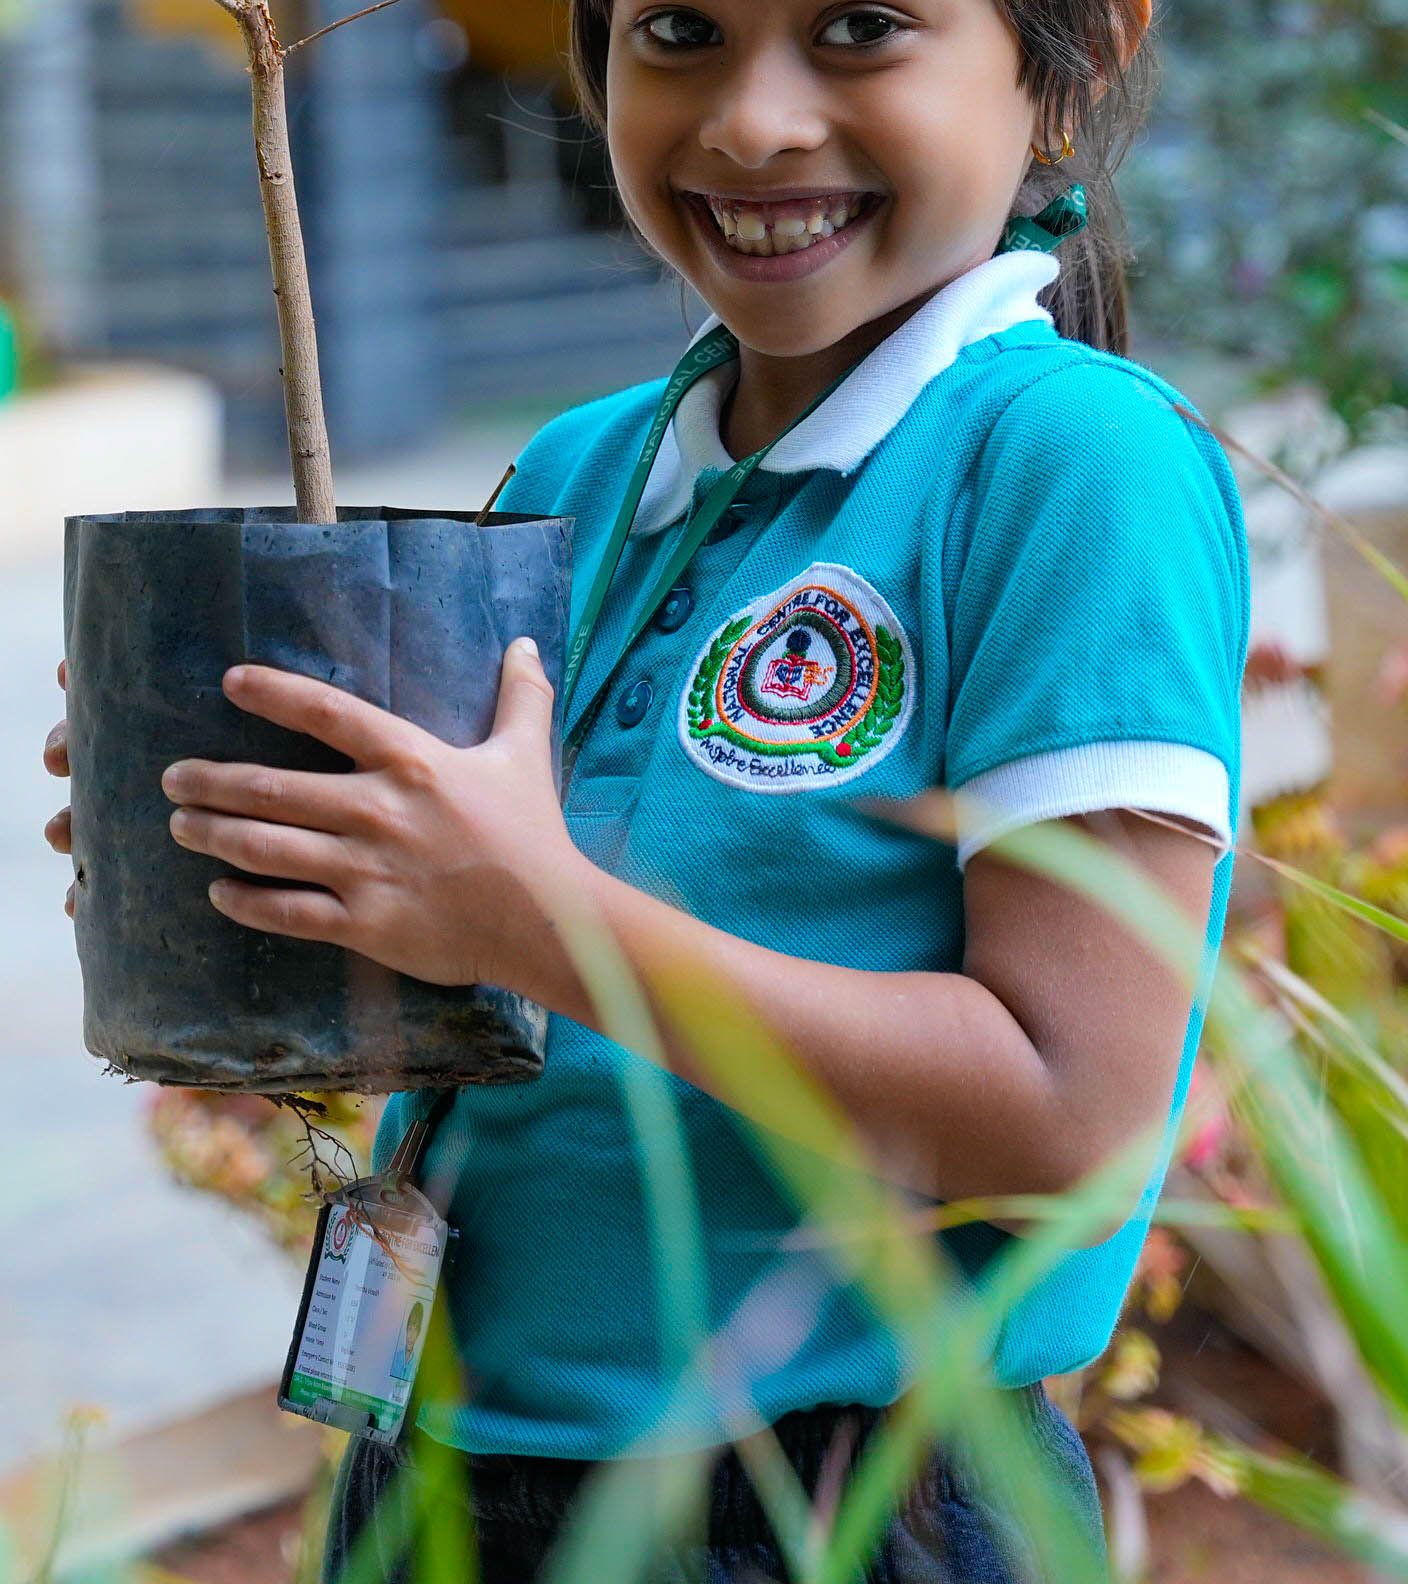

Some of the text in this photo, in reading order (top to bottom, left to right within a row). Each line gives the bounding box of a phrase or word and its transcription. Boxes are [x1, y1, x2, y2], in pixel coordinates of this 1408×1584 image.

[641, 367, 698, 463] NATIONAL
[722, 591, 874, 739] NATIONAL CENTRE FOR EXCELLENCE
